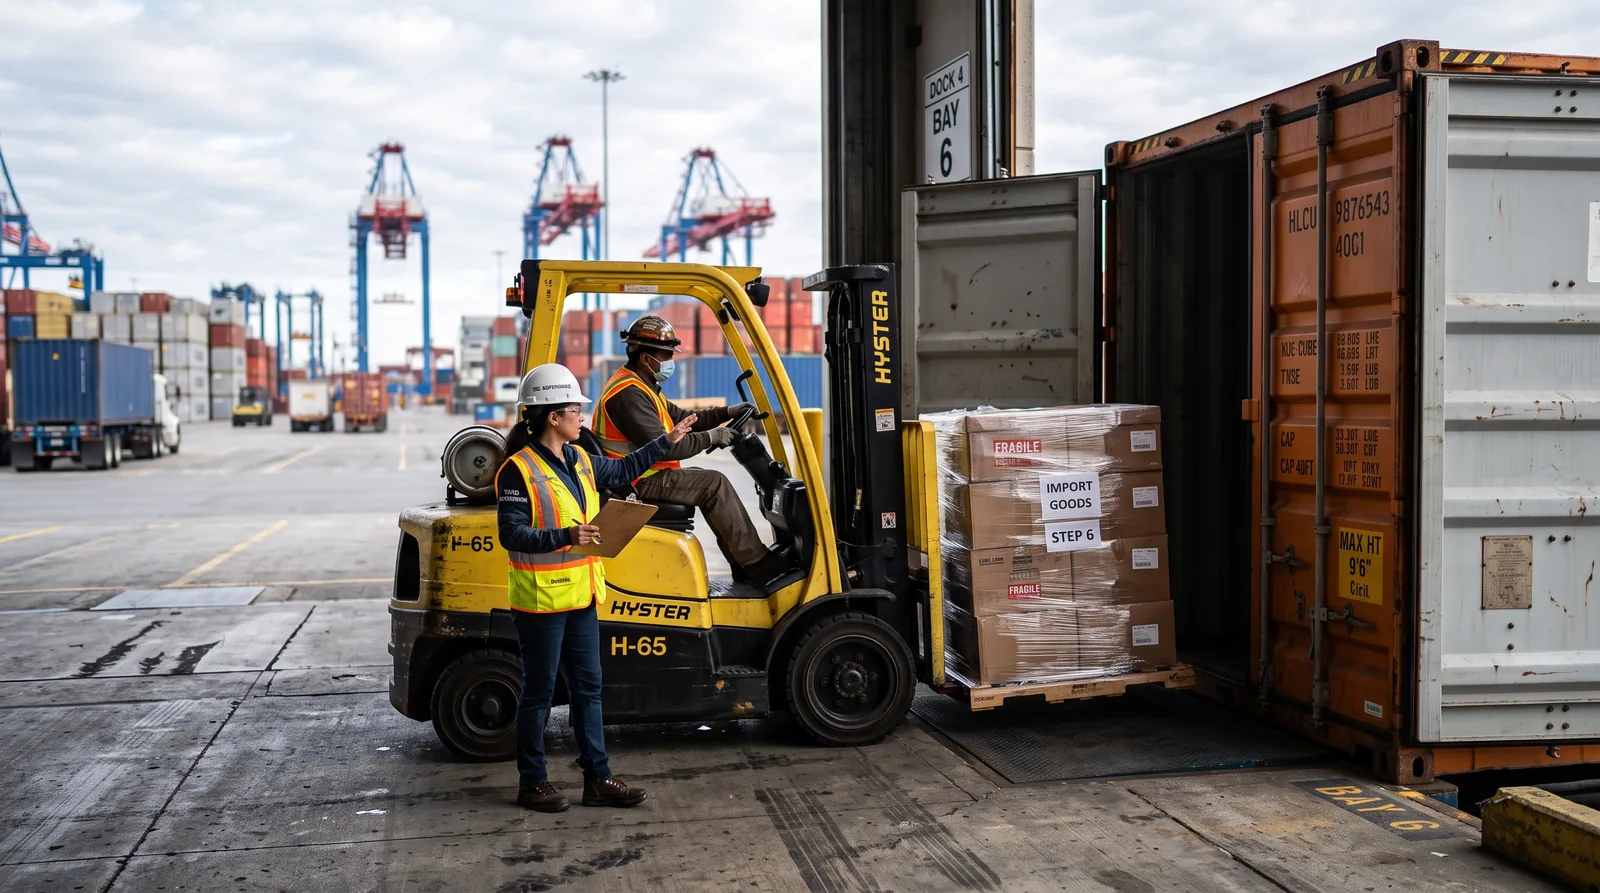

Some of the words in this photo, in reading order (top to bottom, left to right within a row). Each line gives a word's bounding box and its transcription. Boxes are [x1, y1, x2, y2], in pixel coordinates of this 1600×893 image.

[929, 70, 955, 99] DOCK
[957, 65, 964, 83] 4
[933, 98, 960, 135] BAY
[940, 137, 953, 178] 6
[1288, 205, 1317, 233] HLCU
[1335, 190, 1390, 224] 9876543
[871, 289, 892, 384] HYSTER
[994, 440, 1041, 454] FRAGILE
[1280, 432, 1295, 447] CAP
[1280, 458, 1295, 474] CAP
[1046, 480, 1093, 494] IMPORT
[1049, 497, 1092, 510] GOODS
[451, 535, 494, 552] H-65
[1051, 530, 1084, 544] STEP
[1086, 528, 1095, 541] 6
[1339, 530, 1363, 553] MAX
[1367, 536, 1382, 556] HT
[1009, 584, 1040, 595] FRAGILE
[610, 601, 691, 620] HYSTER
[611, 636, 667, 656] H-65
